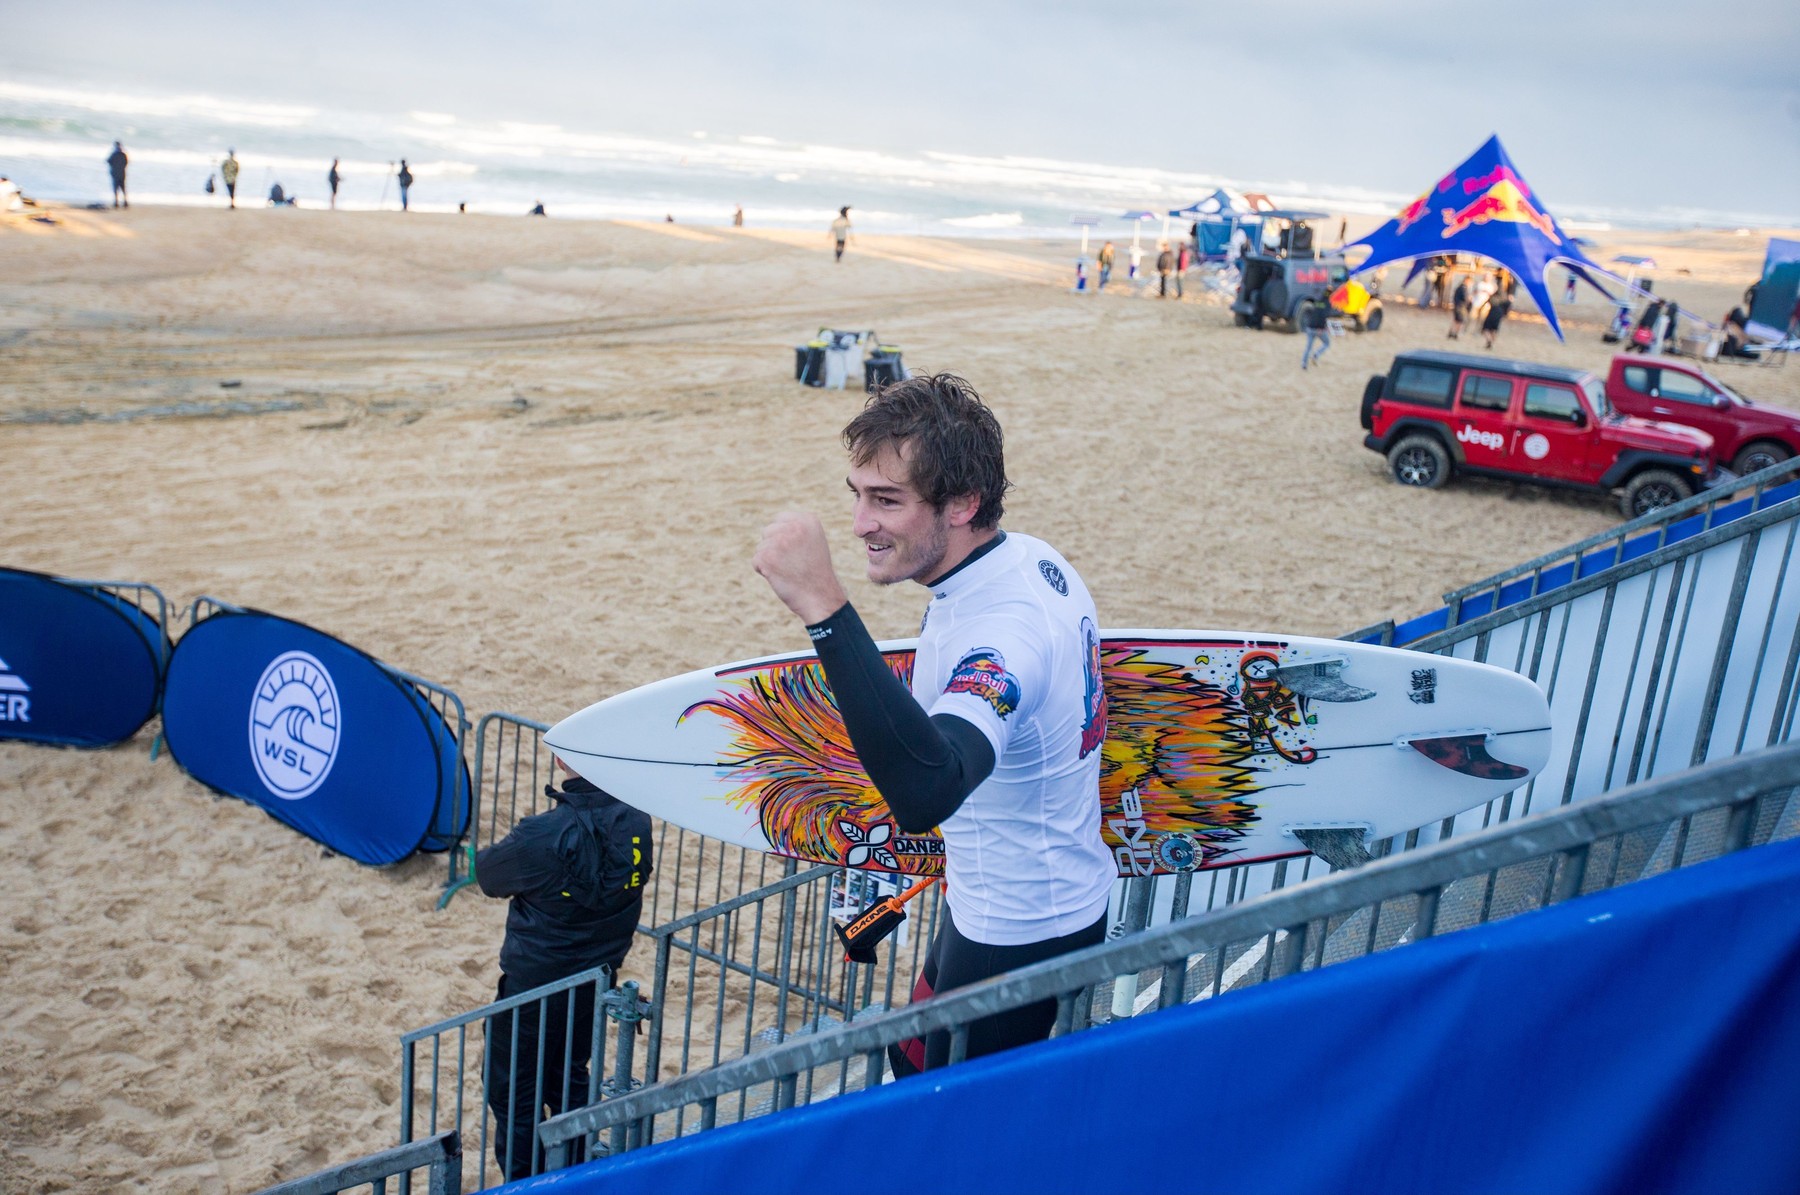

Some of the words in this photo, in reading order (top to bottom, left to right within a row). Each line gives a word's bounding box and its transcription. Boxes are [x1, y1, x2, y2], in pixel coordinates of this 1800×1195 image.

[1456, 424, 1504, 450] Jeep
[979, 672, 1008, 695] Bull
[265, 737, 312, 776] WSL
[850, 904, 890, 936] DAKINE
